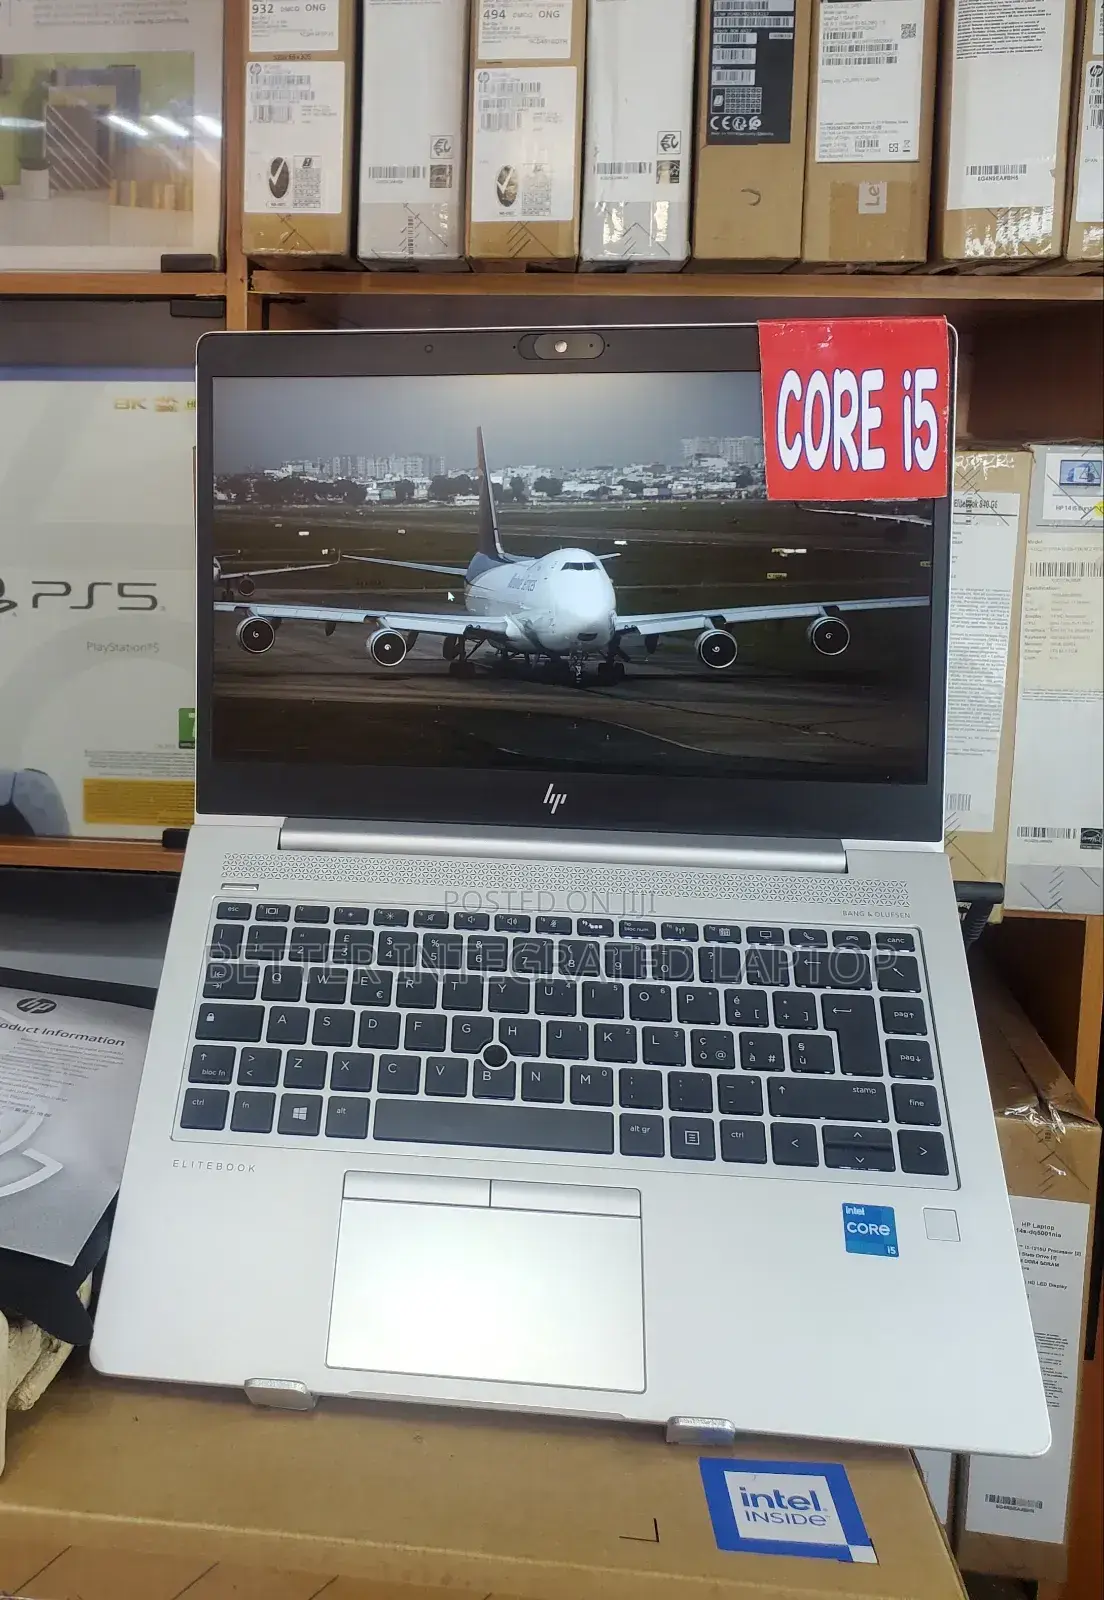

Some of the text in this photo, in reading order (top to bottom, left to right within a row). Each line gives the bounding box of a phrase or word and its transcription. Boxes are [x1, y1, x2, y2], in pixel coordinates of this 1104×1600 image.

[252, 4, 274, 14] 932
[305, 4, 326, 12] ONG
[483, 9, 506, 19] 494
[538, 10, 560, 18] ONG
[776, 367, 939, 472] CORE i5
[31, 581, 158, 611] PS5
[543, 783, 568, 815] hp
[874, 911, 911, 919] OLUFSEN
[386, 936, 393, 946] $
[431, 938, 440, 948] %
[297, 946, 304, 954] 2
[341, 948, 348, 957] 3
[385, 950, 393, 958] 4
[430, 952, 438, 960] 5
[475, 954, 483, 963] 6
[521, 956, 528, 965] 7
[568, 959, 575, 968] 8
[614, 962, 622, 970] 9
[271, 973, 283, 982] Q
[317, 974, 330, 984] W
[360, 976, 369, 986] E
[405, 979, 414, 989] R
[451, 981, 459, 991] T
[497, 984, 507, 993] Y
[376, 990, 383, 999] €
[544, 986, 553, 996] U
[639, 992, 650, 1001] O
[685, 994, 695, 1004] P
[16, 997, 57, 1014] hp
[277, 1014, 287, 1025] A
[323, 1016, 331, 1027] S
[368, 1019, 378, 1029] D
[414, 1021, 422, 1031] F
[461, 1023, 472, 1034] G
[508, 1026, 518, 1036] H
[41, 1028, 125, 1047] Information
[555, 1029, 563, 1039] J
[603, 1032, 613, 1042] K
[652, 1034, 660, 1045] L
[715, 1050, 727, 1061] @
[767, 1054, 776, 1063] #
[294, 1058, 303, 1069] Z
[340, 1060, 350, 1071] X
[387, 1063, 397, 1073] C
[201, 1068, 226, 1077] bloc fn
[435, 1065, 445, 1076] V
[482, 1071, 492, 1081] B
[531, 1071, 541, 1082] N
[580, 1074, 592, 1085] M
[852, 1086, 877, 1096] stamp
[191, 1098, 205, 1106] ctrl
[242, 1101, 250, 1109] fn
[909, 1098, 925, 1107] fine
[336, 1107, 346, 1115] alt
[630, 1124, 651, 1134] alt gr
[730, 1131, 744, 1139] ctrl
[173, 1159, 256, 1172] ELITEBOOK
[845, 1206, 865, 1216] intel
[1032, 1223, 1055, 1231] Laptop
[887, 1246, 896, 1255] i5
[1048, 1282, 1068, 1290] Display
[739, 1486, 821, 1511] intel
